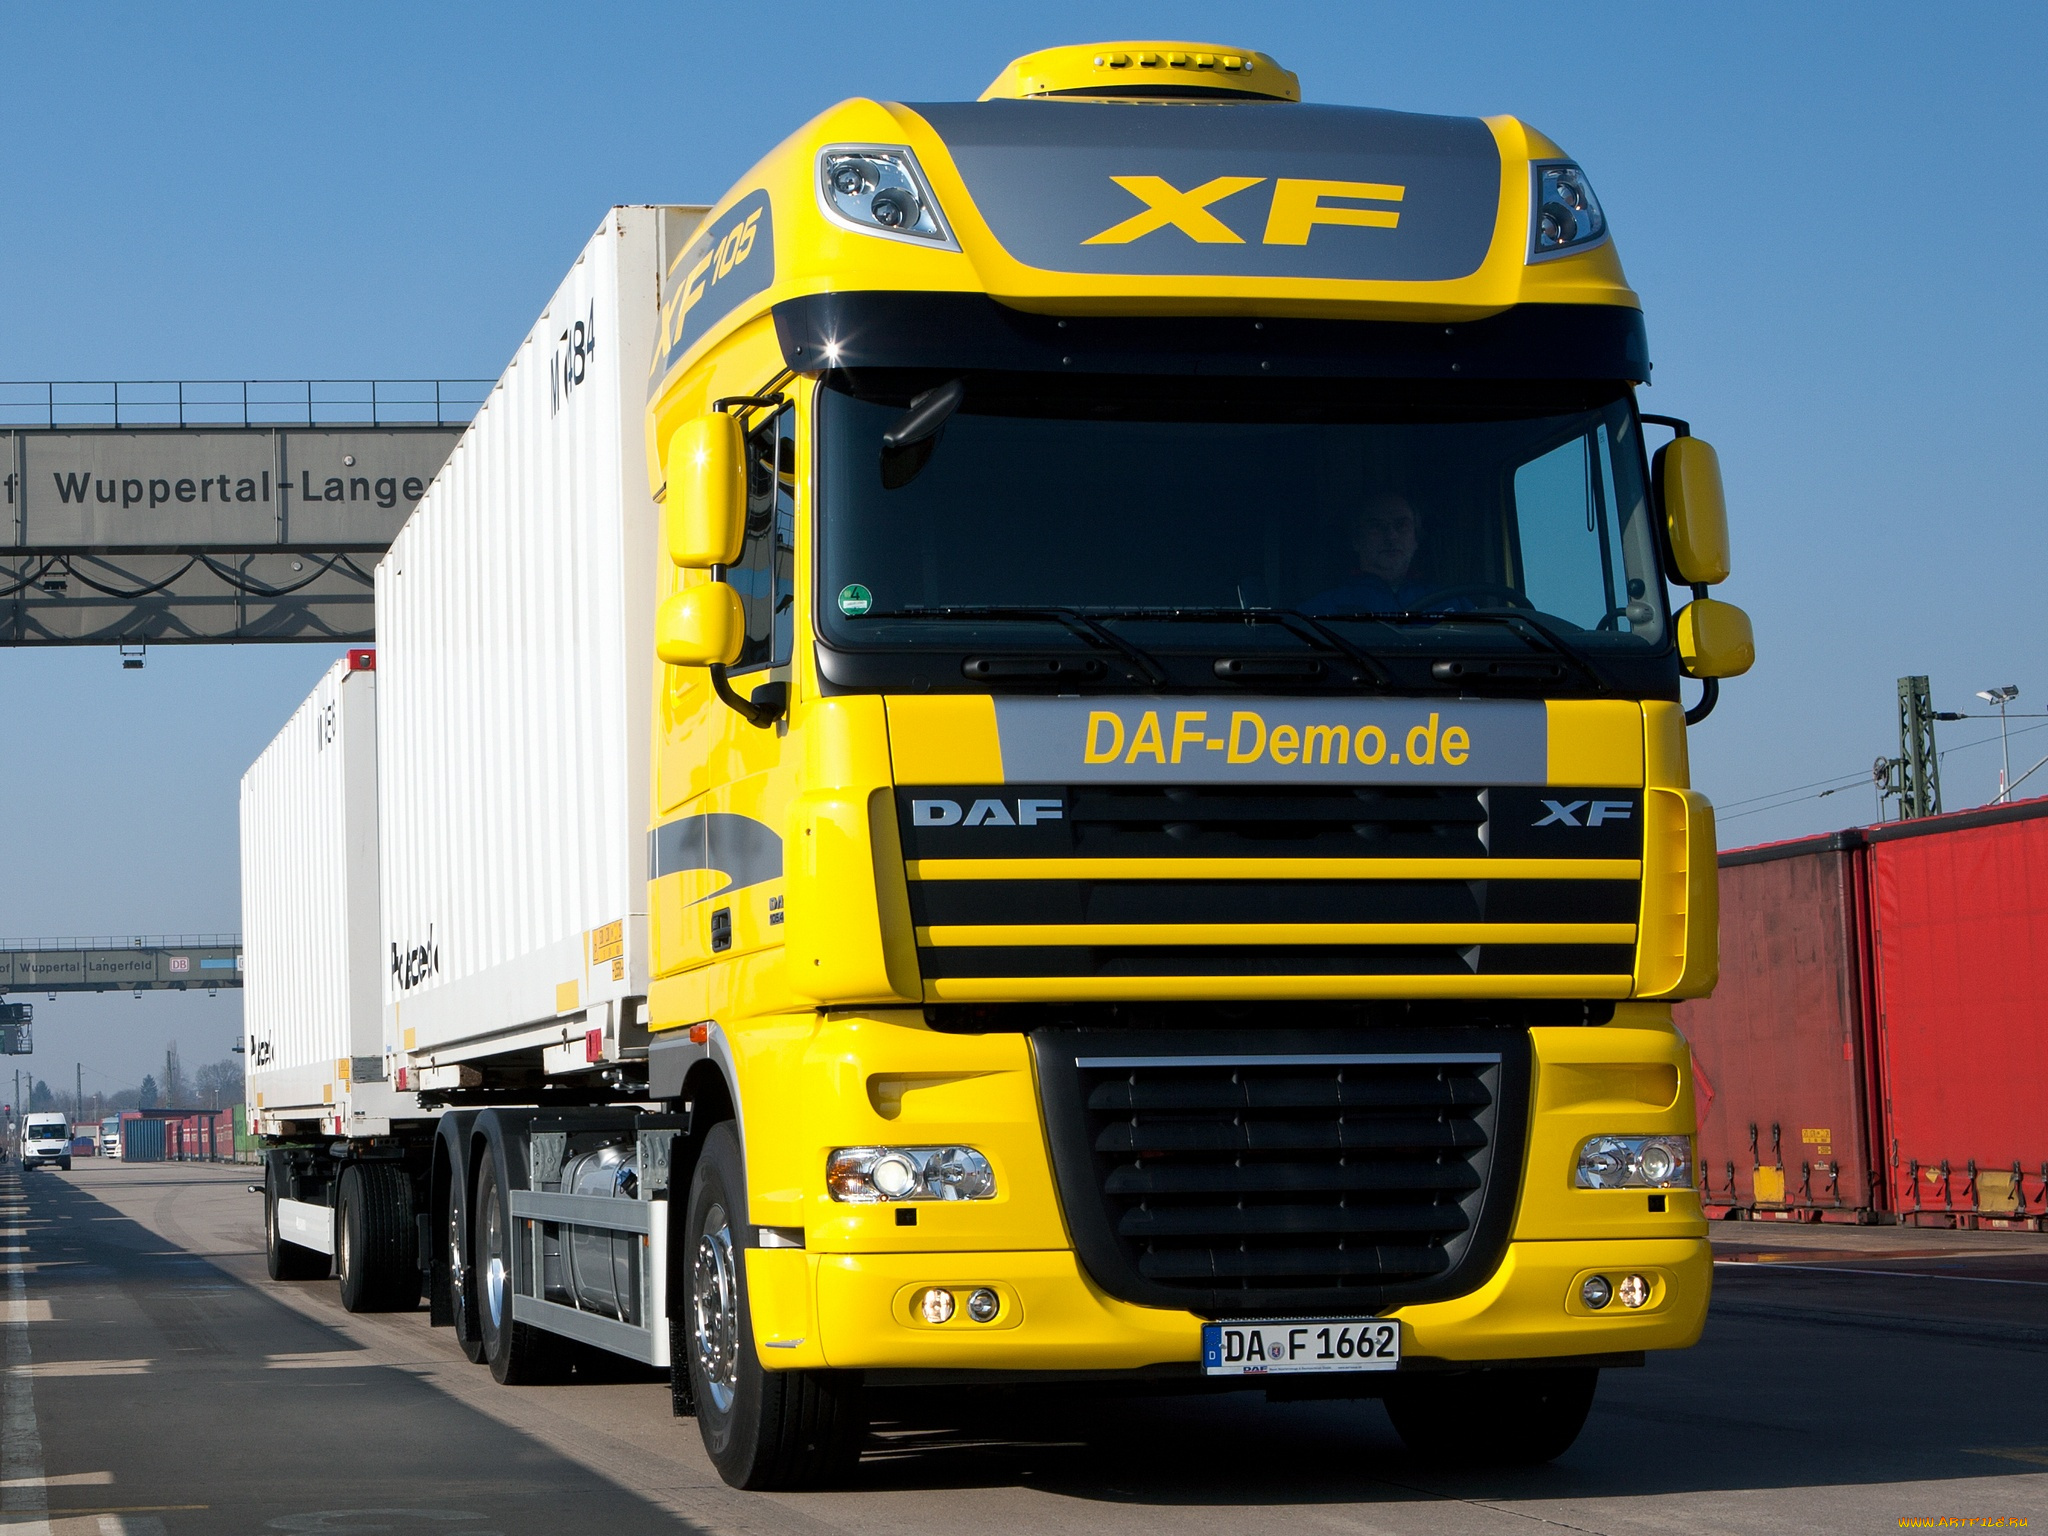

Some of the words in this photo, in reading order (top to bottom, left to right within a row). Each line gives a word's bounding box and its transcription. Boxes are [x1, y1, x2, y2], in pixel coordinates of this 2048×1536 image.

[1081, 175, 1406, 246] XF
[649, 249, 714, 377] XF
[711, 205, 764, 287] 105
[54, 471, 434, 508] Wuppertal-Lange
[850, 586, 860, 600] 4
[1083, 710, 1471, 767] DAF-Demo.de
[911, 798, 1064, 827] DAF
[1531, 800, 1634, 828] XF
[172, 960, 187, 969] DB
[1208, 1350, 1216, 1360] D
[1224, 1330, 1266, 1362] DA
[1288, 1329, 1308, 1360] F
[1316, 1326, 1394, 1358] 1662
